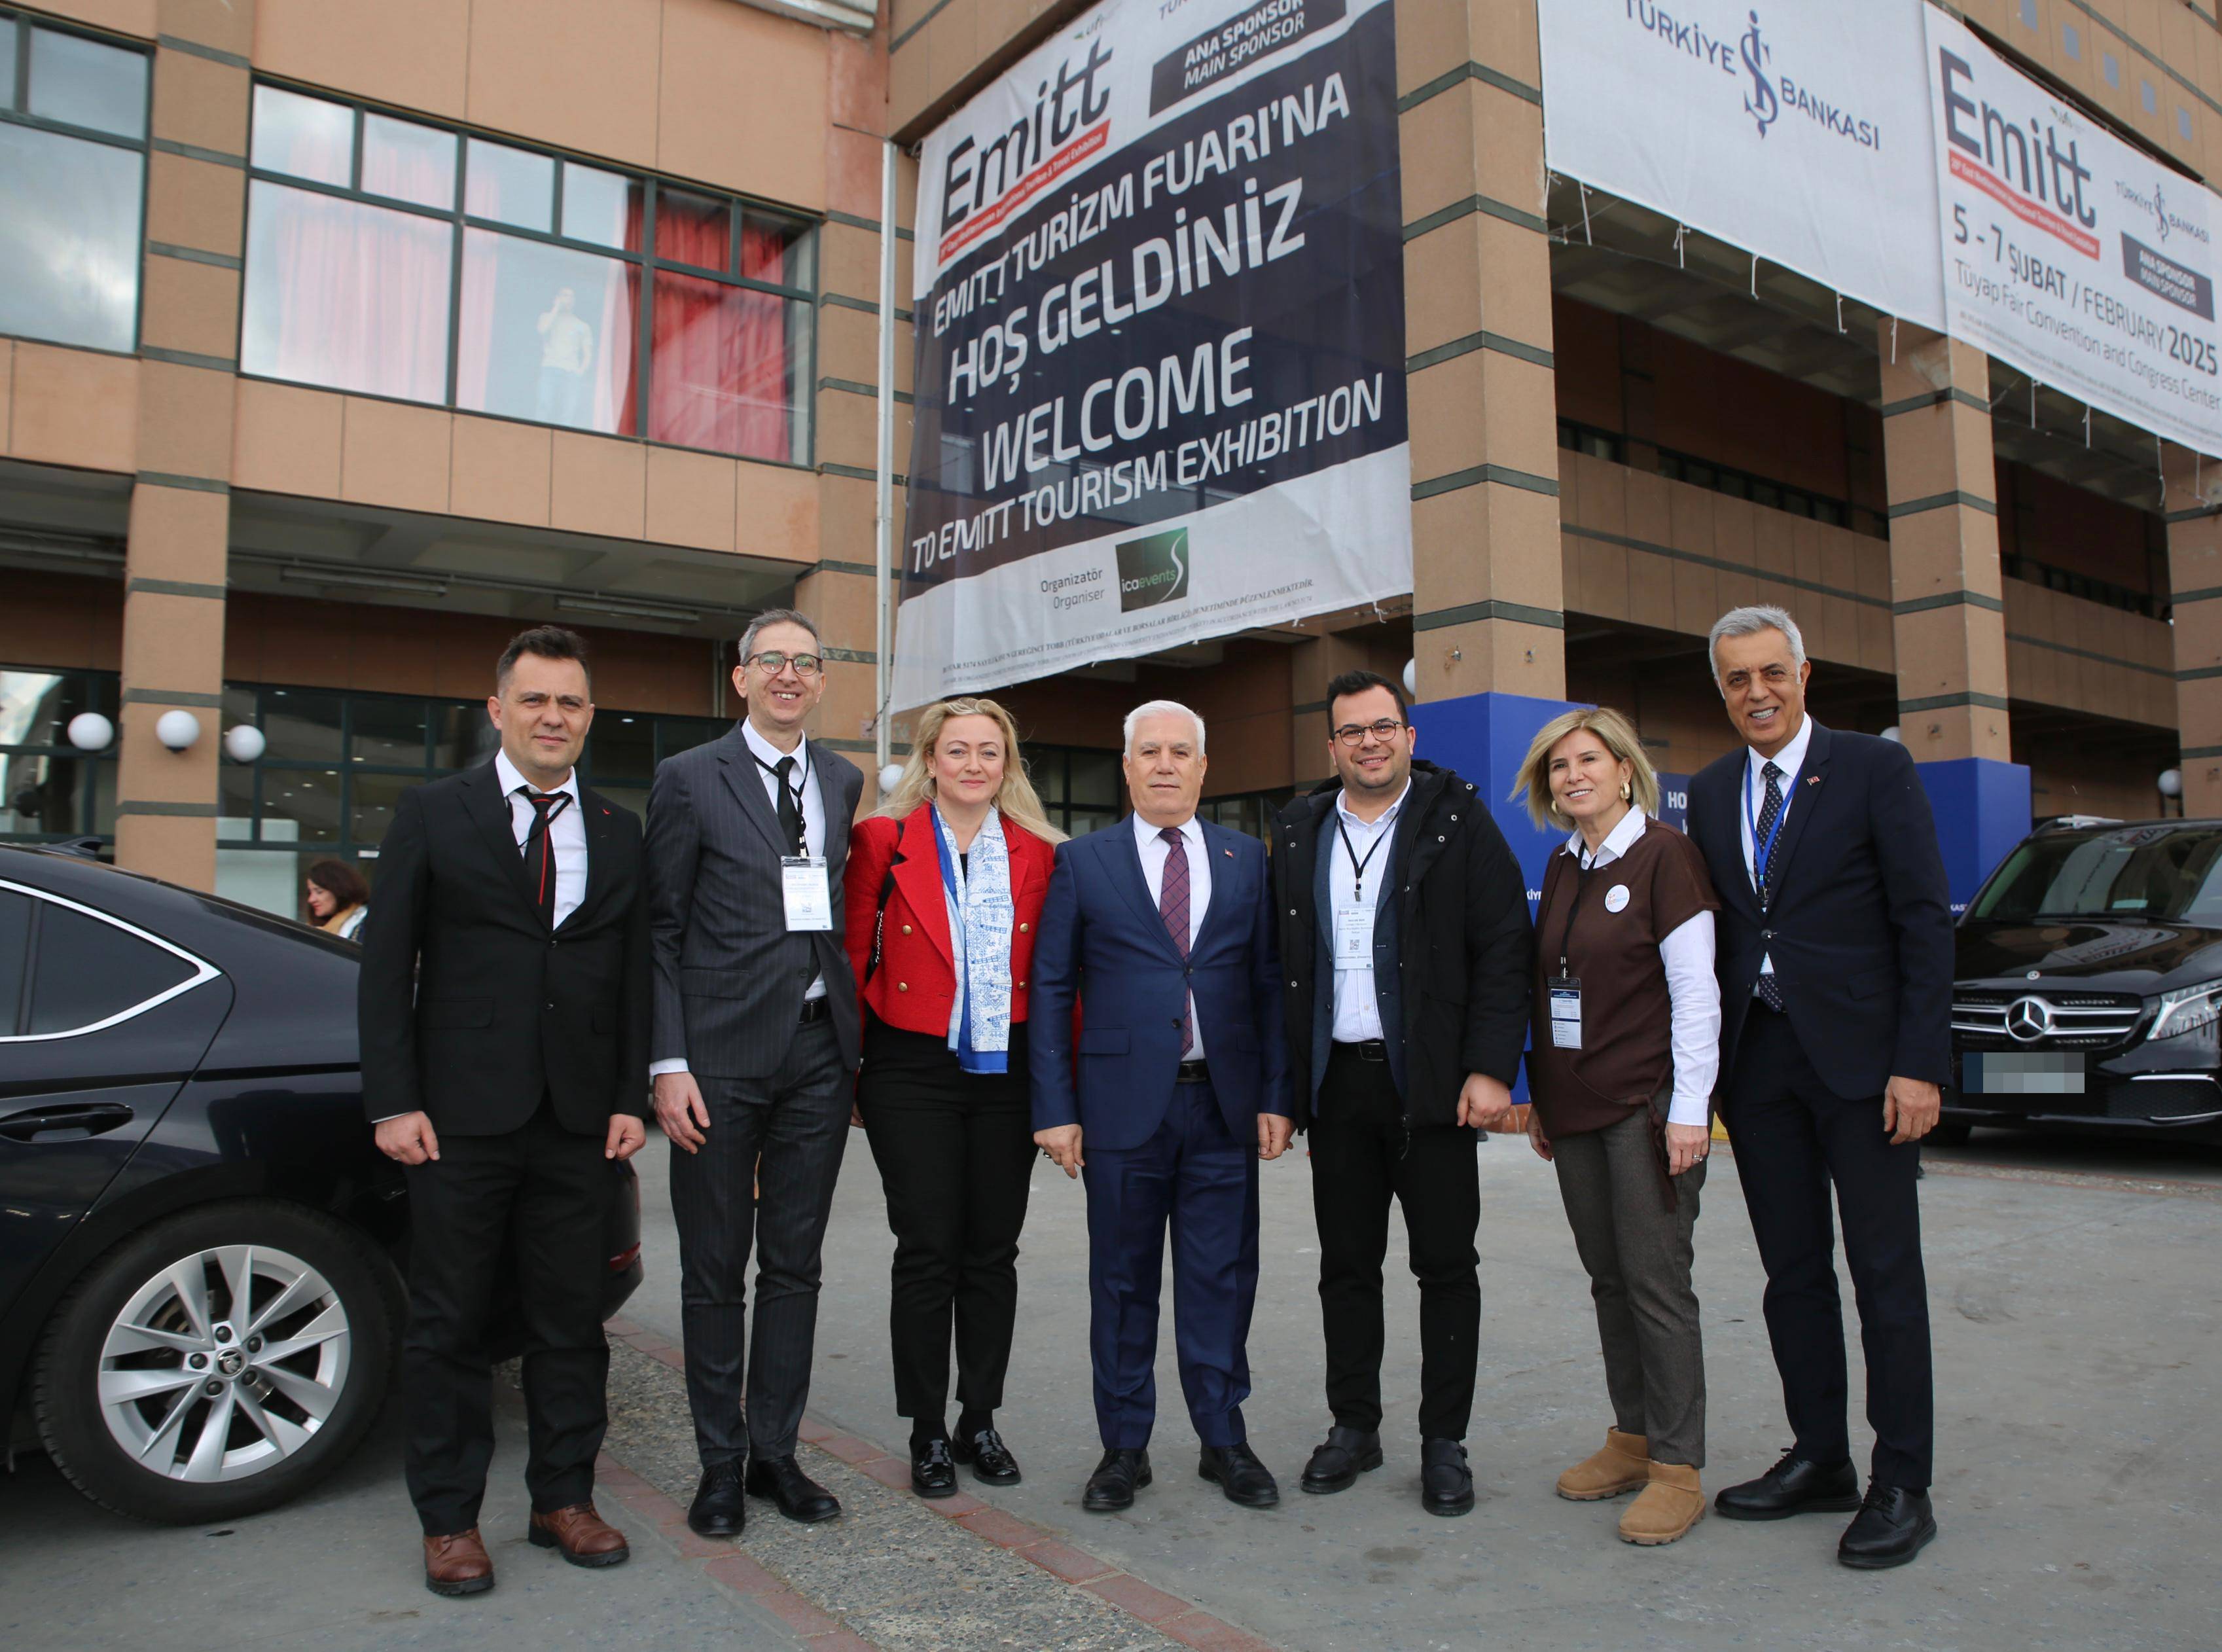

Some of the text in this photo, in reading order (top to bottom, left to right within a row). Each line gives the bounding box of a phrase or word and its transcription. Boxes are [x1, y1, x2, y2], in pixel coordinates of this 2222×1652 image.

[1184, 10, 1305, 90] MAIN SPONSOR
[1184, 41, 1220, 69] ANA
[1625, 0, 1736, 75] TÜRKİYE
[1780, 75, 1880, 151] BANKASI
[933, 72, 1350, 338] EMITT TURİZM FUARI'NA
[941, 35, 1114, 238] Emitt
[1939, 45, 2096, 229] Emitt
[948, 177, 1306, 405] HOŞ GELDİNİZ
[1954, 202, 1967, 244] 5
[1990, 223, 2003, 262] 7
[2008, 243, 2066, 301] ŞUBAT
[2071, 281, 2079, 309] /
[2083, 286, 2166, 353] FEBRUARY
[2167, 324, 2218, 377] 2025
[2168, 213, 2210, 244] BANKASI
[982, 326, 1253, 492] WELCOME
[1954, 257, 1999, 306] Tüyap
[2001, 285, 2024, 315] Fair
[2025, 295, 2102, 355] Convention
[2102, 342, 2126, 368] and
[2127, 350, 2180, 395] Congress
[2180, 377, 2221, 411] Center
[912, 372, 1383, 574] TO EMITT TOURISM EXHIBITION
[1041, 567, 1104, 594] Organizatör
[1053, 588, 1106, 610] Organiser
[1121, 569, 1177, 593] icaevents
